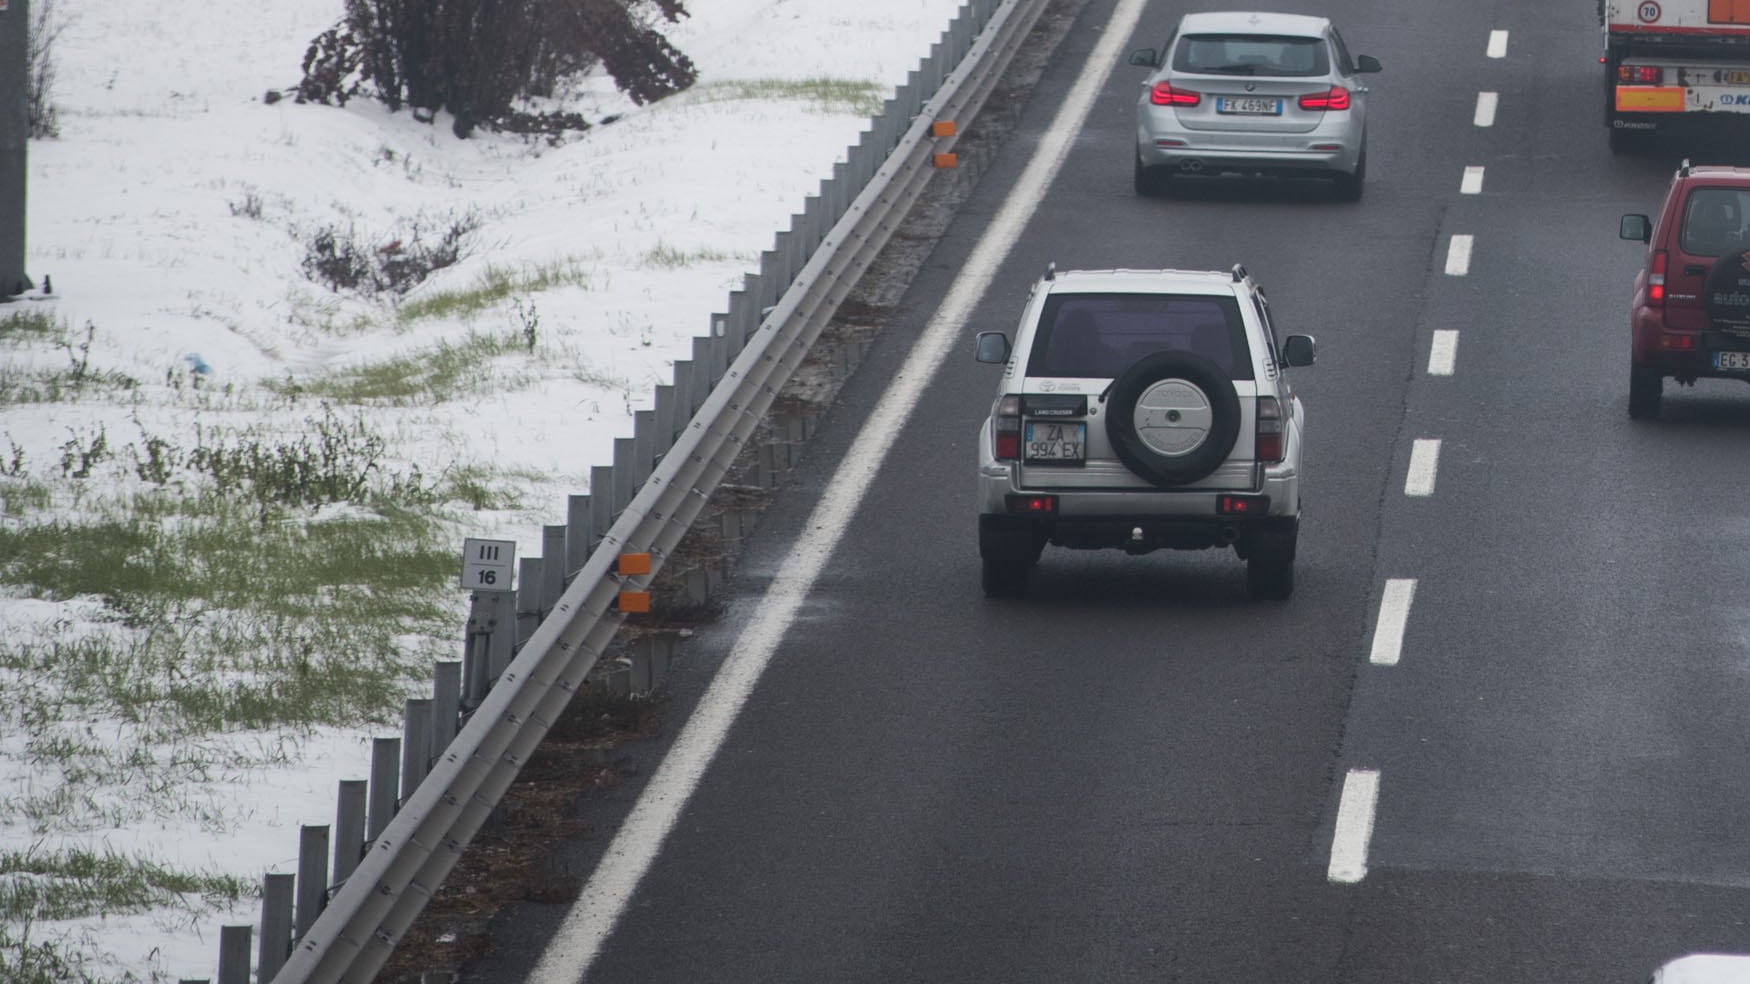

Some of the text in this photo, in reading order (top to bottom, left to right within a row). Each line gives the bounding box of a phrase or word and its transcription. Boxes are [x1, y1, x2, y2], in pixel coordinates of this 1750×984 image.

[1047, 425, 1064, 441] ZA
[1062, 442, 1080, 459] EX
[478, 569, 496, 585] 16
